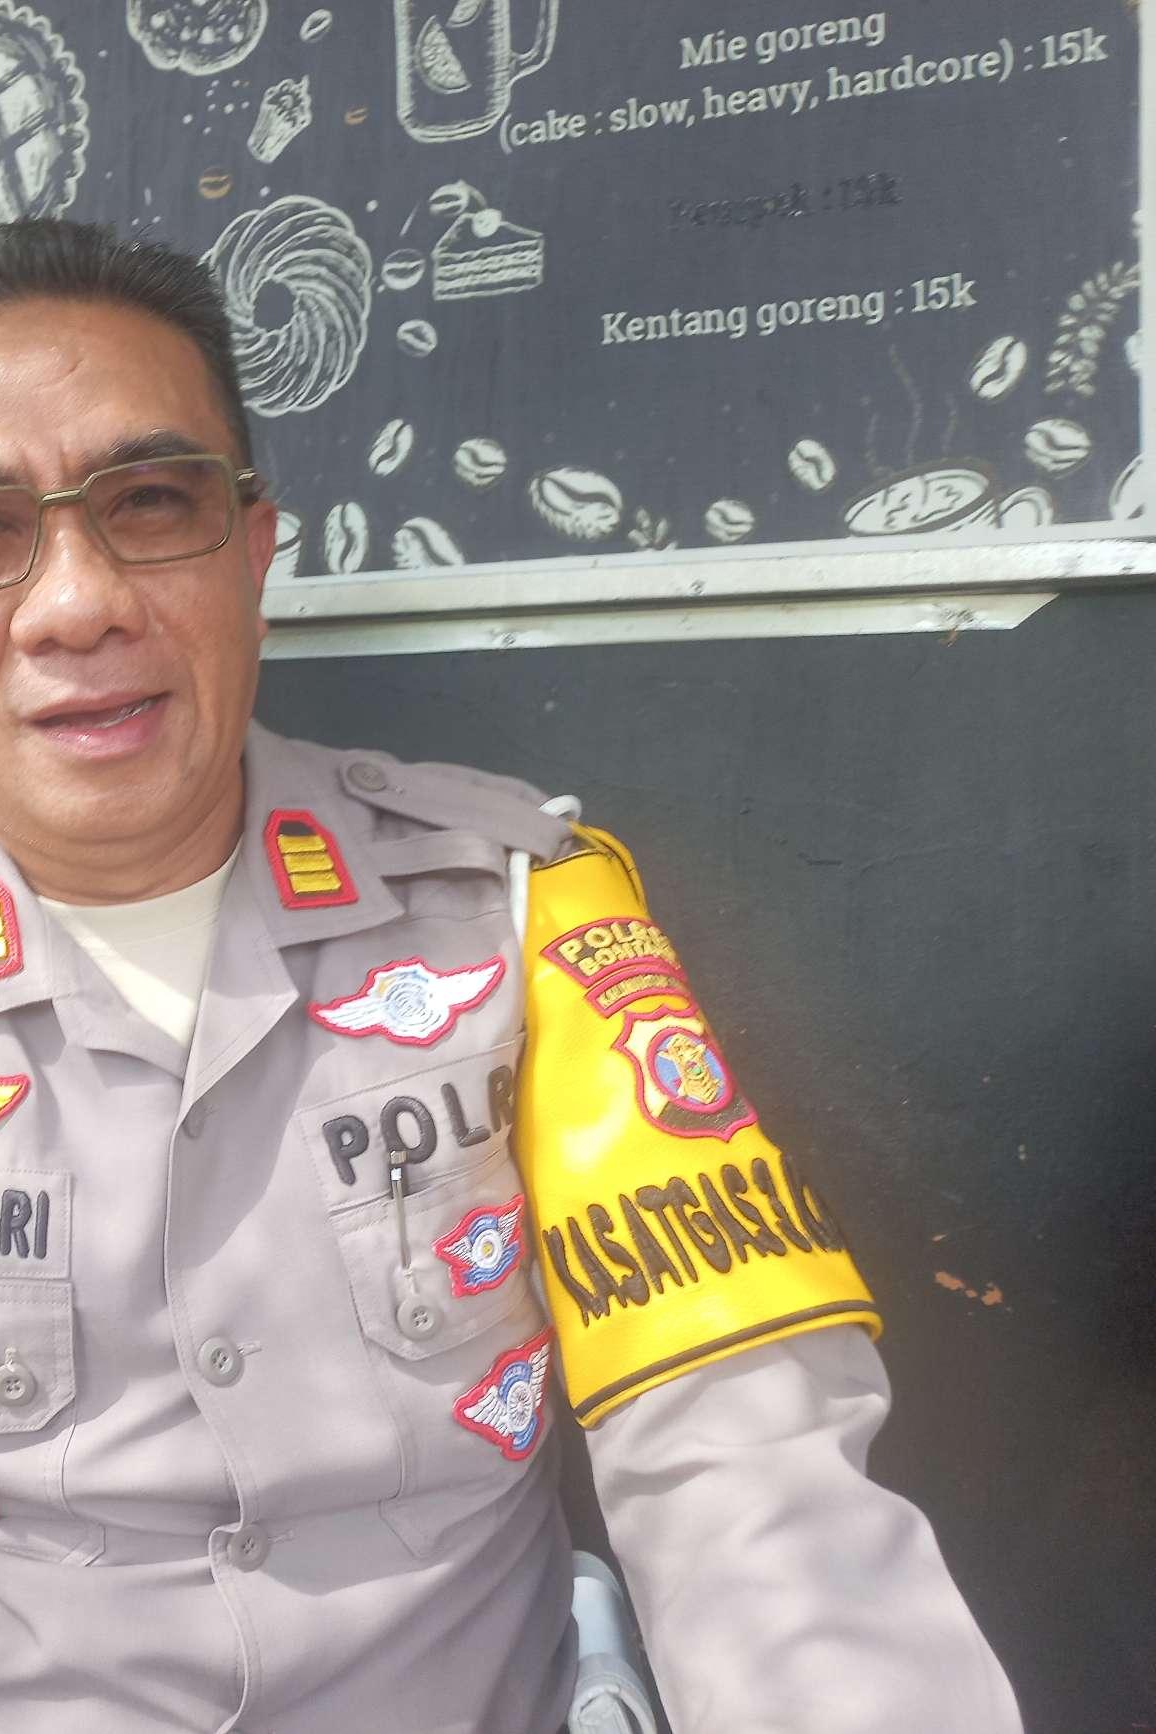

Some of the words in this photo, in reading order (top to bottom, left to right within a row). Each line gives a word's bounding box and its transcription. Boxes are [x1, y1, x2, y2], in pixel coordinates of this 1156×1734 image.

[609, 97, 695, 134] slow,
[701, 79, 819, 120] heavy,
[826, 37, 1014, 102] hardcore)
[1041, 26, 1109, 70] 15k
[679, 29, 747, 69] Mie
[755, 12, 886, 64] goreng
[601, 305, 748, 345] Kentang
[756, 289, 885, 336] goreng
[911, 272, 978, 313] 15k
[322, 1064, 515, 1186] POLR
